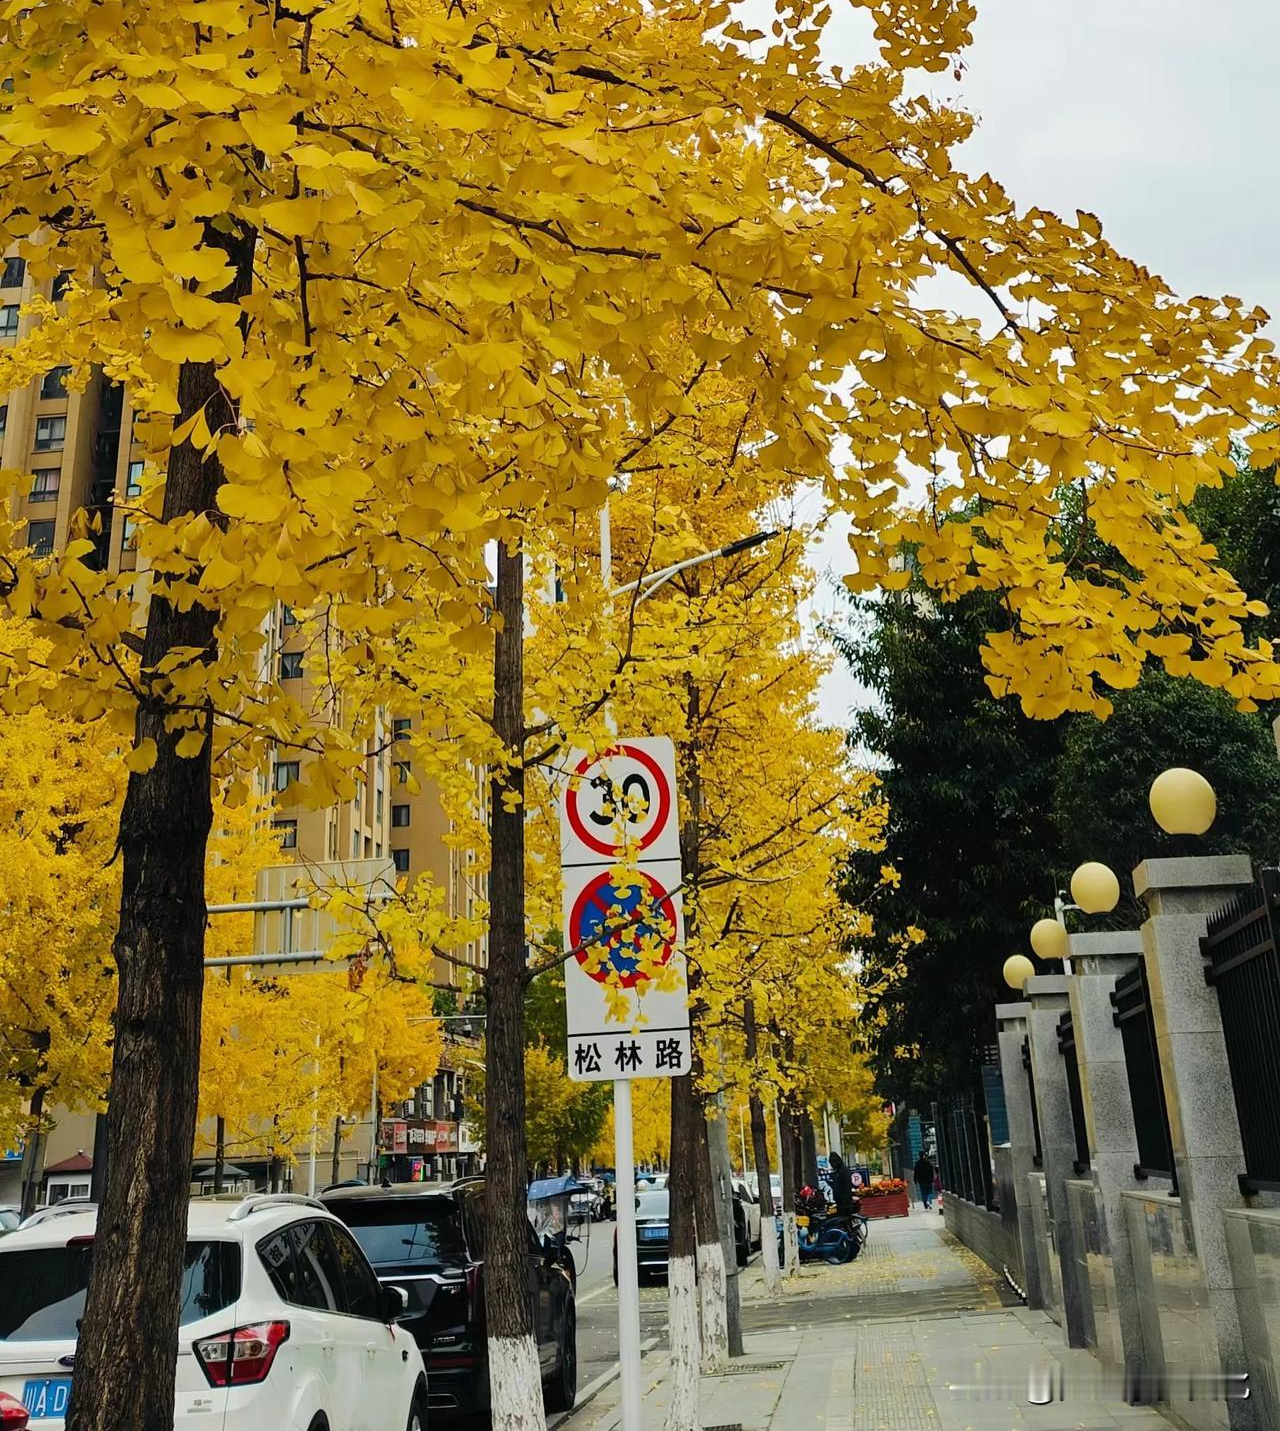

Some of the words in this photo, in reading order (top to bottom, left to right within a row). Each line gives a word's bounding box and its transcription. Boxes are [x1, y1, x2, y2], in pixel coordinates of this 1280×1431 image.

[589, 773, 651, 826] 30
[574, 1037, 684, 1075] 松林路
